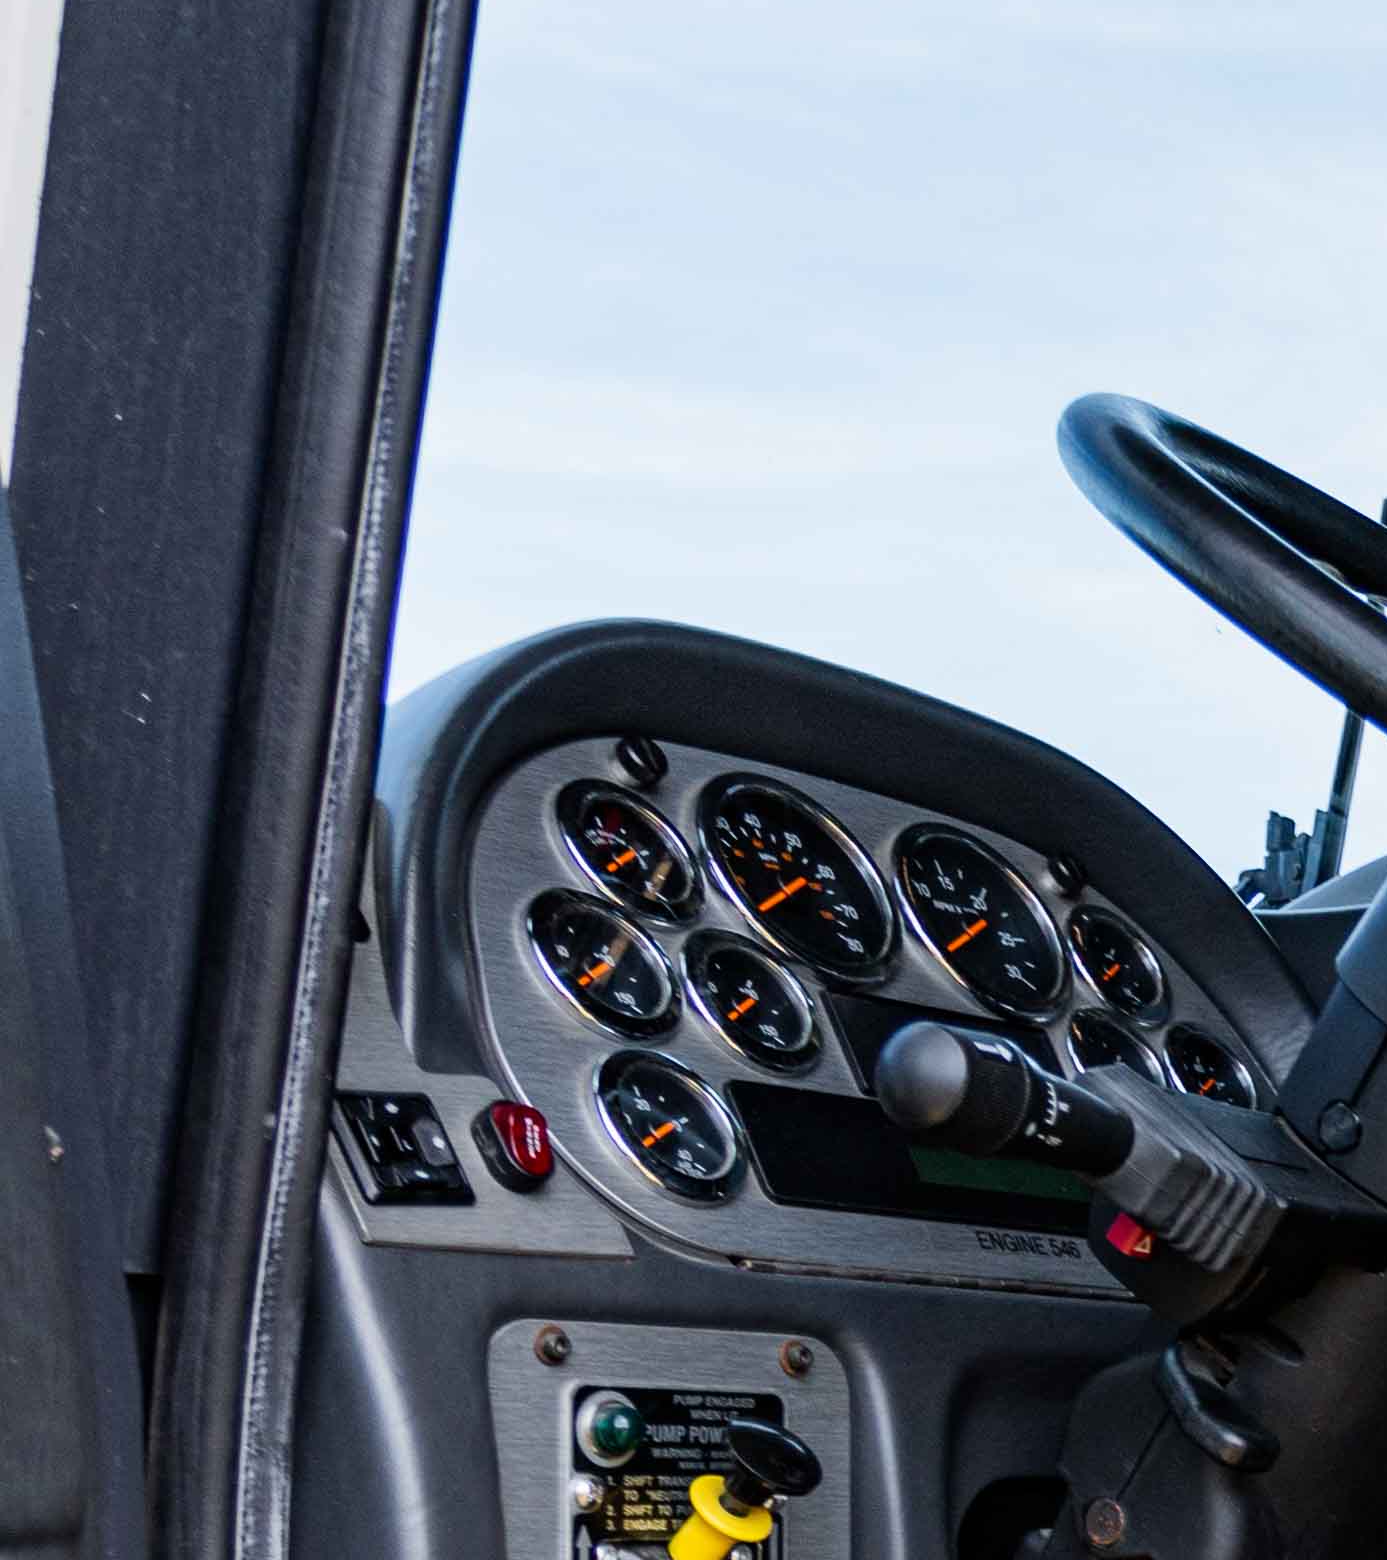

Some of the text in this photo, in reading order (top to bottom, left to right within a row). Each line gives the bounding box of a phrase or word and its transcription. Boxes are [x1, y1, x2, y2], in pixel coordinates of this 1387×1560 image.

[912, 879, 931, 898] 10
[938, 875, 954, 892] 15
[975, 1230, 1081, 1259] ENGINE 546
[689, 1426, 729, 1444] POW
